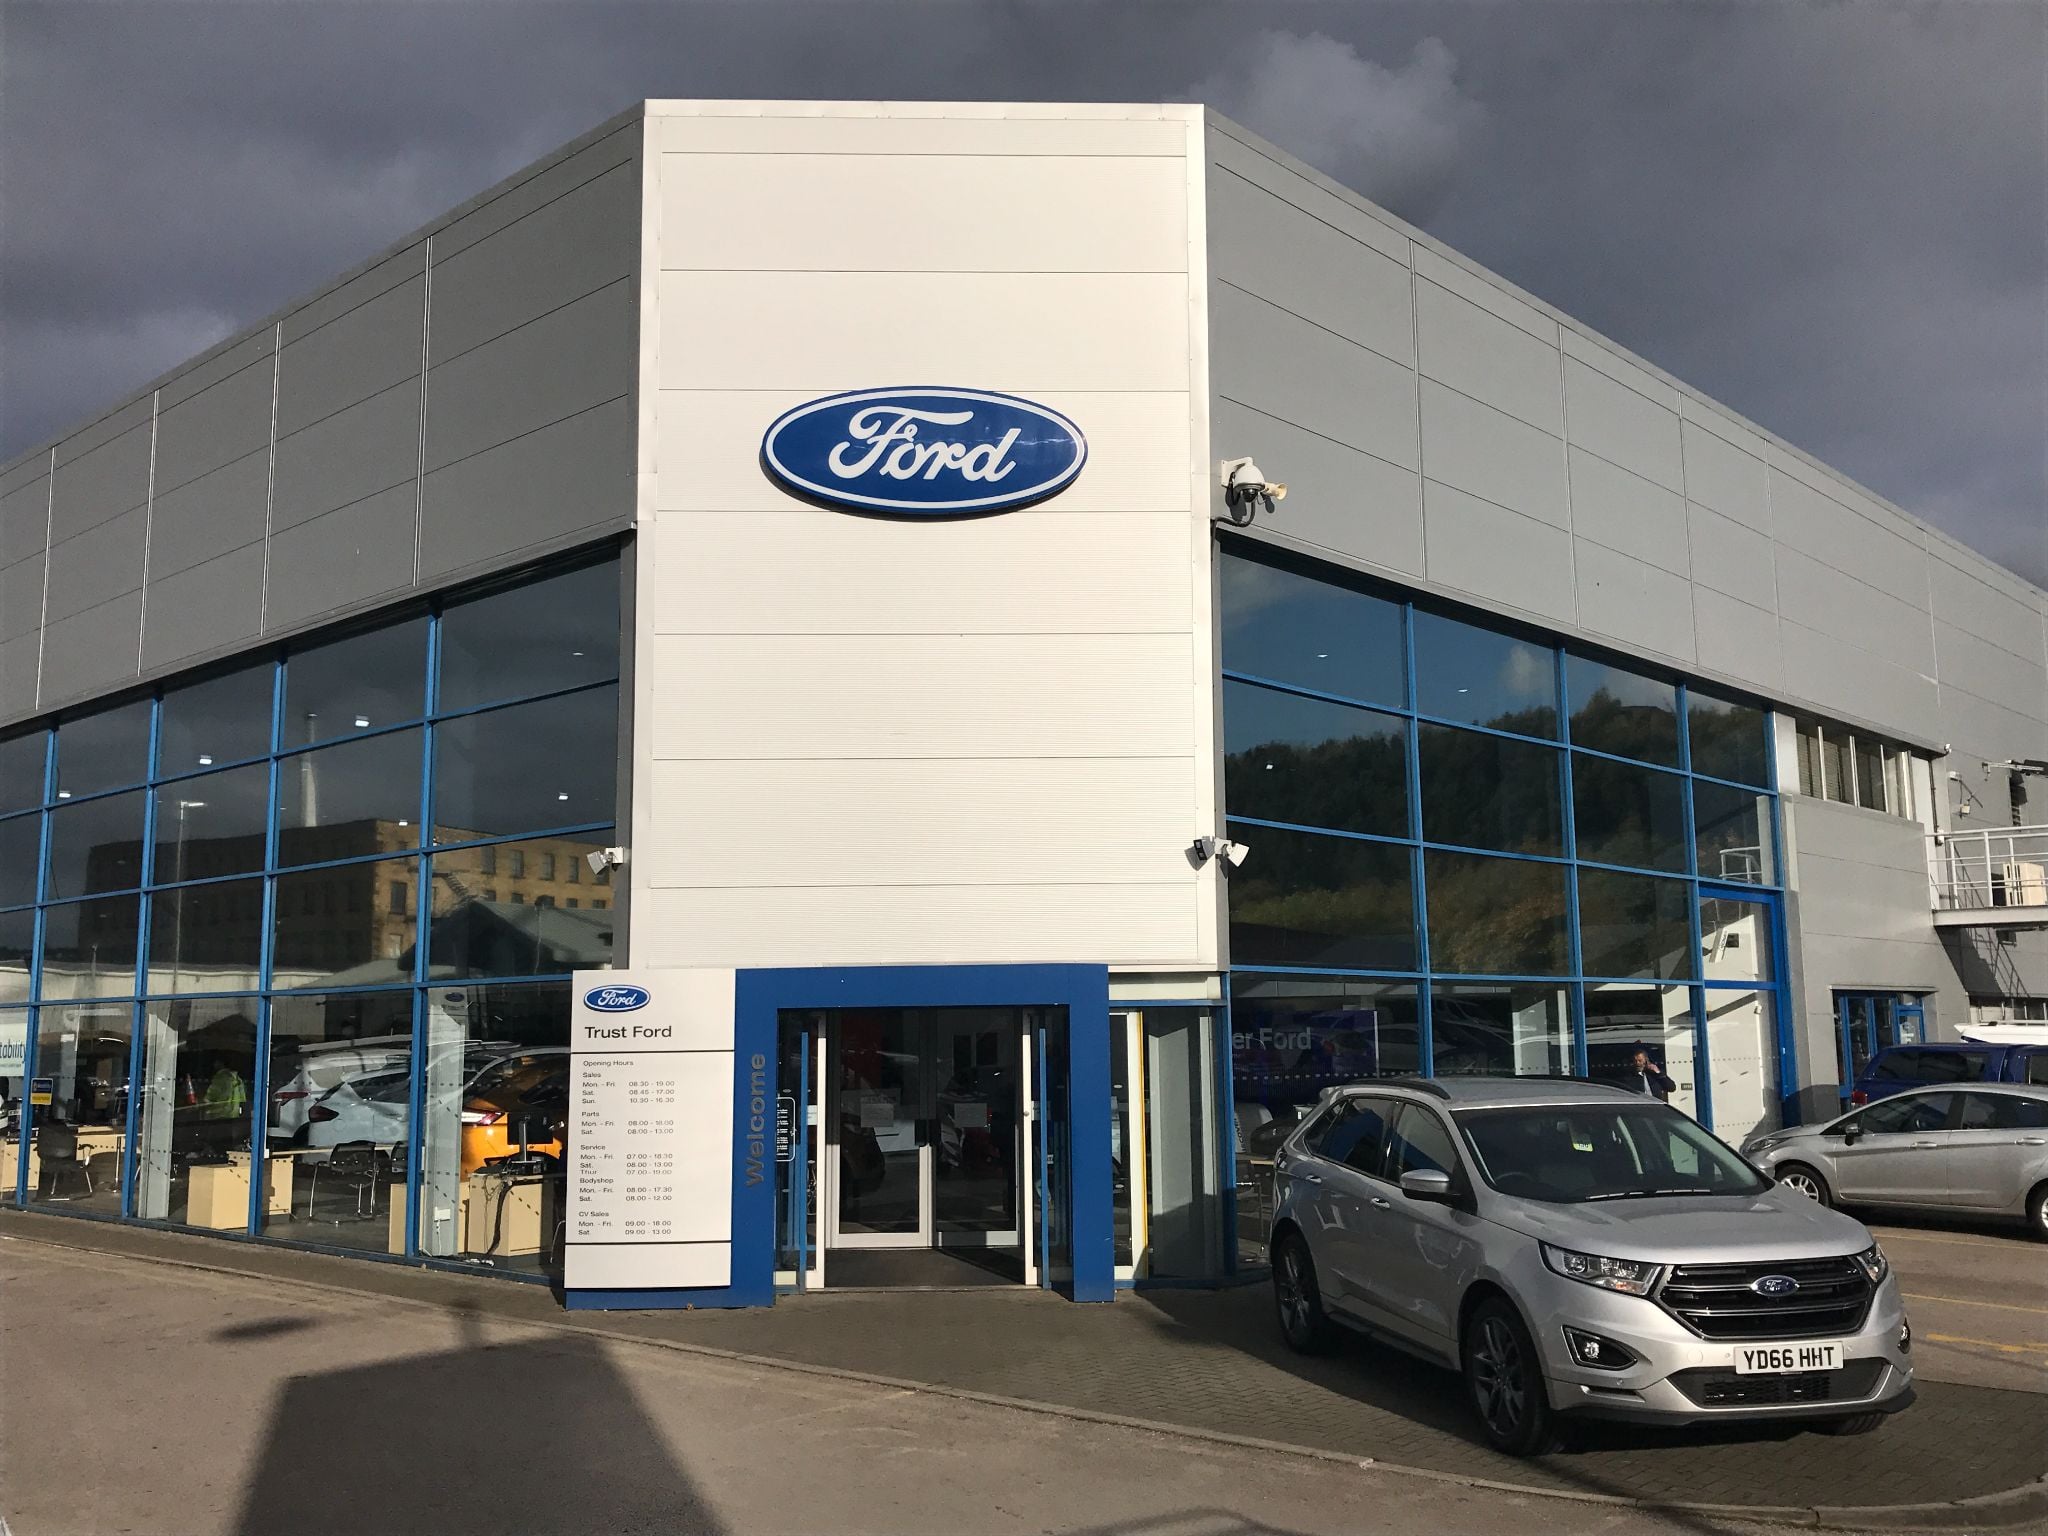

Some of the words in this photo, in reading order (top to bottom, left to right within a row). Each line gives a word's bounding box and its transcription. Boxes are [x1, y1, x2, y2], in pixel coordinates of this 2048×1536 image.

[828, 406, 1021, 482] Ford
[597, 989, 638, 1006] Ford
[585, 1026, 627, 1039] Trust
[633, 1025, 672, 1038] Ford
[1260, 1027, 1312, 1050] Ford
[0, 1038, 26, 1063] ability
[583, 1060, 611, 1068] Opening
[745, 1053, 766, 1188] Welcome
[1743, 1348, 1794, 1370] YD66
[1799, 1346, 1835, 1368] HHT
